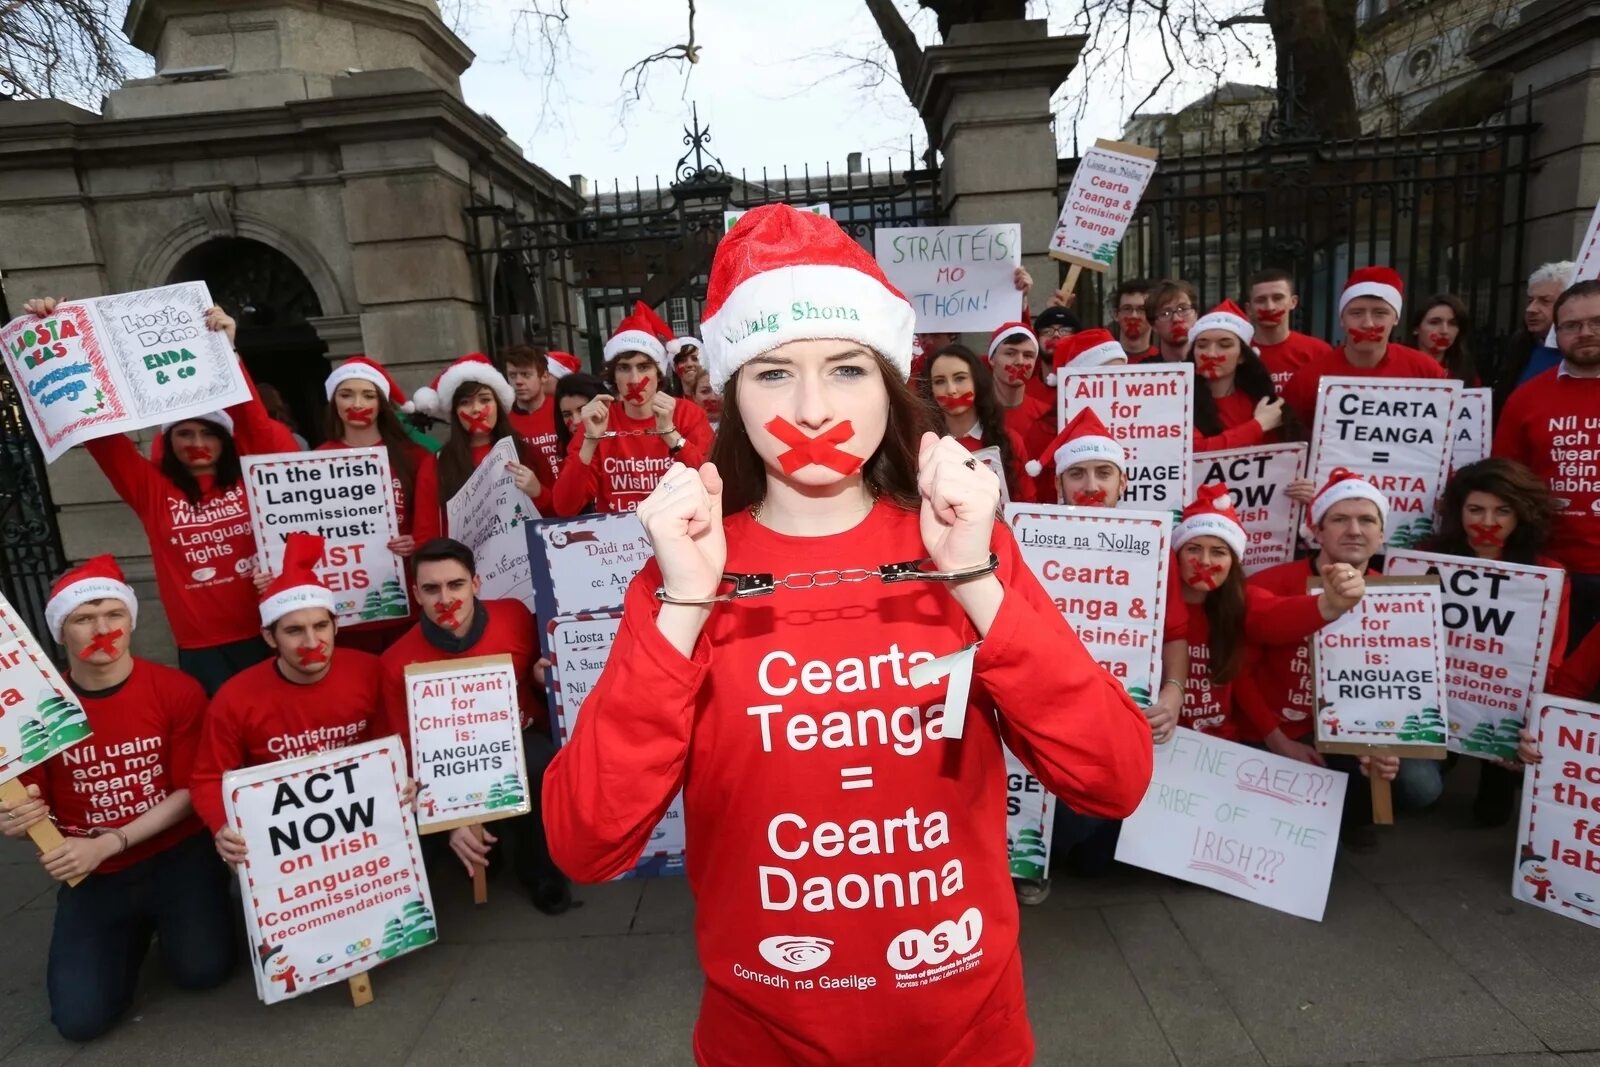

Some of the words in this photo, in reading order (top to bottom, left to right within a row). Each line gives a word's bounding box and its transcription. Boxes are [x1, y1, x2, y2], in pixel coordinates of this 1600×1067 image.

[1091, 175, 1129, 194] Cearta
[1079, 187, 1120, 208] Teanga
[1122, 200, 1132, 211] &
[1072, 201, 1128, 223] Coimisinéir
[1075, 215, 1116, 236] Teanga
[893, 228, 1016, 264] STRÁITÉIS?
[937, 267, 966, 284] MO
[791, 301, 860, 322] Shona
[912, 288, 989, 318] THÓIN!
[121, 305, 193, 334] Liosta
[10, 320, 79, 360] LIOSTA
[143, 348, 197, 370] ENDA
[156, 370, 171, 385] &
[177, 366, 197, 379] CO
[1075, 381, 1104, 399] All
[1112, 380, 1117, 397] I
[1125, 380, 1177, 397] want
[1110, 402, 1142, 418] for
[1339, 393, 1438, 418] CEARTA
[1105, 423, 1181, 439] istmas
[1336, 419, 1434, 444] TEANGA
[1549, 416, 1577, 432] Níl
[1553, 431, 1589, 446] ach
[1123, 447, 1138, 460] s:
[256, 468, 279, 485] In
[286, 466, 322, 483] the
[329, 460, 379, 479] Irish
[1126, 466, 1180, 481] UAGE
[1203, 455, 1273, 484] ACT
[1558, 462, 1597, 476] féin
[610, 473, 664, 490] Wishli
[1124, 484, 1167, 501] HTS
[1367, 474, 1426, 493] ARTA
[266, 481, 377, 506] Language
[1228, 484, 1276, 508] OW
[265, 503, 384, 526] Commissioner
[1241, 508, 1268, 522] ish
[179, 521, 252, 546] Languag
[1021, 528, 1066, 546] Liosta
[1074, 536, 1089, 547] na
[1097, 532, 1151, 555] Nollag
[185, 544, 233, 564] rights
[320, 543, 365, 568] IST
[622, 543, 634, 551] na
[495, 554, 529, 576] hÉirea
[601, 557, 612, 566] An
[616, 554, 634, 564] Mol
[322, 569, 370, 592] EIS
[591, 579, 604, 588] cc:
[610, 573, 627, 585] An
[1042, 560, 1129, 586] Cearta
[1054, 597, 1118, 621] anga
[1128, 598, 1148, 620] &
[1362, 600, 1367, 613] I
[1374, 600, 1425, 613] want
[1361, 616, 1390, 630] for
[1442, 602, 1515, 636] OW
[564, 630, 604, 644] Liosta
[1077, 625, 1149, 648] isinéir
[1324, 634, 1431, 648] Christmas
[1447, 631, 1504, 654] Irish
[565, 660, 575, 671] A
[1365, 650, 1389, 665] is:
[1327, 669, 1433, 683] LANGUAGE
[421, 684, 445, 699] All
[451, 683, 456, 697] I
[461, 677, 503, 694] want
[1339, 685, 1422, 700] RIGHTS
[451, 696, 475, 711] for
[1182, 702, 1221, 717] hairt
[1447, 690, 1518, 711] ndations
[419, 709, 509, 731] Christmas
[267, 719, 367, 753] Christmas
[455, 727, 476, 742] is:
[1558, 726, 1600, 756] Ní
[62, 745, 96, 766] Níl
[105, 736, 162, 757] uaim
[422, 740, 512, 764] LANGUAGE
[1169, 736, 1236, 778] FINE
[72, 760, 116, 779] ach
[124, 753, 159, 770] mo
[433, 756, 503, 778] RIGHTS
[1562, 760, 1600, 785] ac
[73, 764, 163, 793] theanga
[271, 763, 359, 816] ACT
[85, 789, 166, 824] labhairt
[90, 790, 134, 808] féin
[142, 783, 155, 796] a
[666, 810, 679, 819] na
[1215, 803, 1249, 824] OF
[1270, 817, 1327, 849] THE
[268, 797, 375, 856] NOW
[767, 806, 950, 861] Cearta
[280, 854, 313, 875] on
[322, 831, 378, 862] Irish
[277, 855, 391, 904] Language
[758, 858, 964, 913] Daonna
[264, 868, 410, 927] Commissioners
[270, 884, 412, 943] recommendations
[898, 920, 973, 960] USI
[918, 970, 926, 978] of
[926, 962, 956, 977] Students
[962, 948, 983, 964] Ireland
[733, 962, 790, 989] Conradh
[795, 979, 814, 990] na
[819, 975, 877, 990] Gaeilge
[895, 981, 919, 989] Aontas
